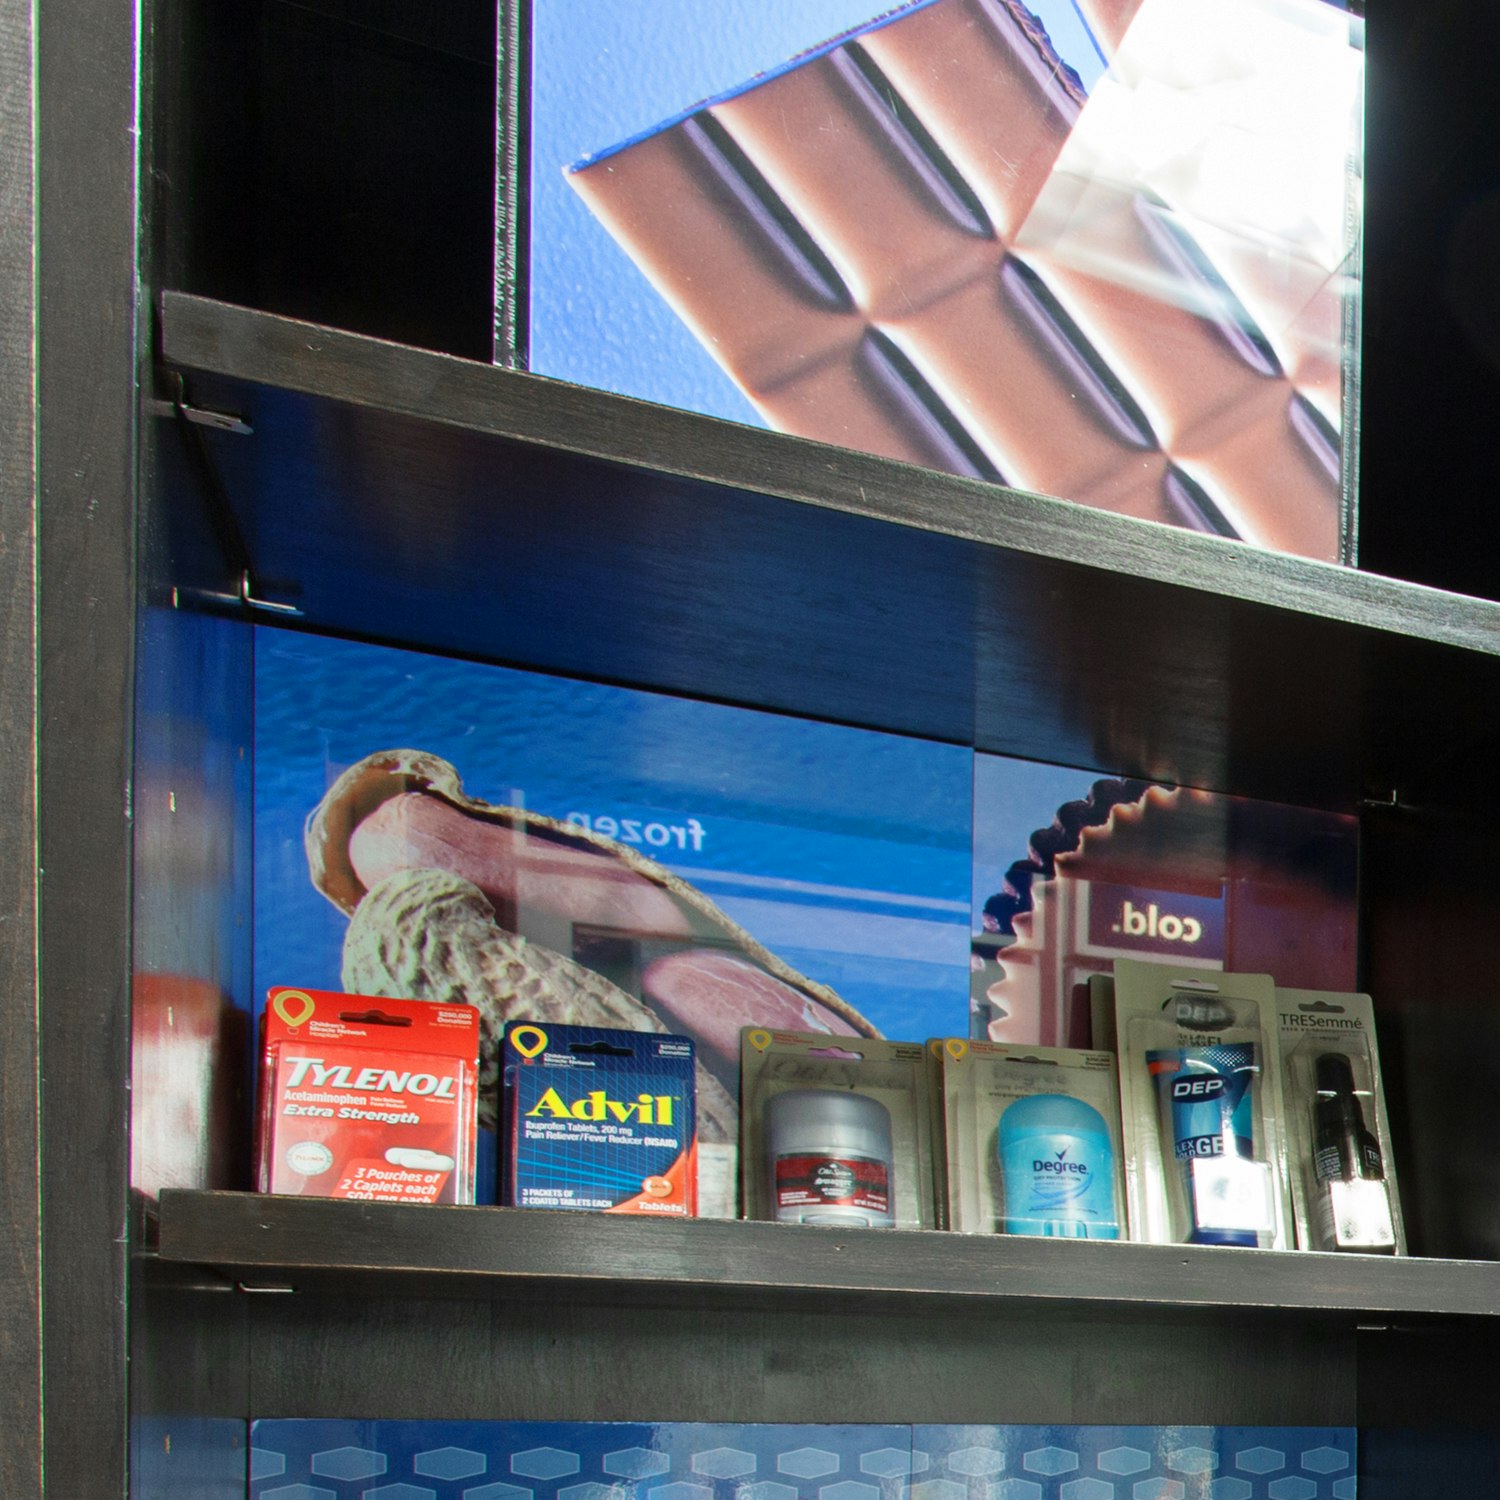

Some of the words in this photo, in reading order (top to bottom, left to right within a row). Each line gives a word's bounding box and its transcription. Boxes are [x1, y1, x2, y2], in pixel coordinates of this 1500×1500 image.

[1280, 1013, 1364, 1029] TRESemmé
[285, 1056, 456, 1099] TYLENOL
[1173, 1080, 1224, 1097] DEP
[284, 1089, 367, 1106] Acetaminophen
[524, 1086, 675, 1126] Advil
[283, 1103, 335, 1118] Extra
[337, 1107, 421, 1124] Strength
[525, 1120, 566, 1134] Ibuprofen
[601, 1125, 618, 1135] 200
[619, 1127, 633, 1137] mg
[525, 1130, 545, 1140] Pain
[609, 1135, 643, 1146] Reducer
[354, 1166, 365, 1179] 3
[366, 1168, 422, 1184] Pouches
[424, 1172, 441, 1184] of
[1032, 1159, 1088, 1175] Degree
[341, 1178, 351, 1190] 2
[353, 1180, 403, 1194] Caplets
[405, 1184, 437, 1196] each
[638, 1201, 683, 1213] Tablets
